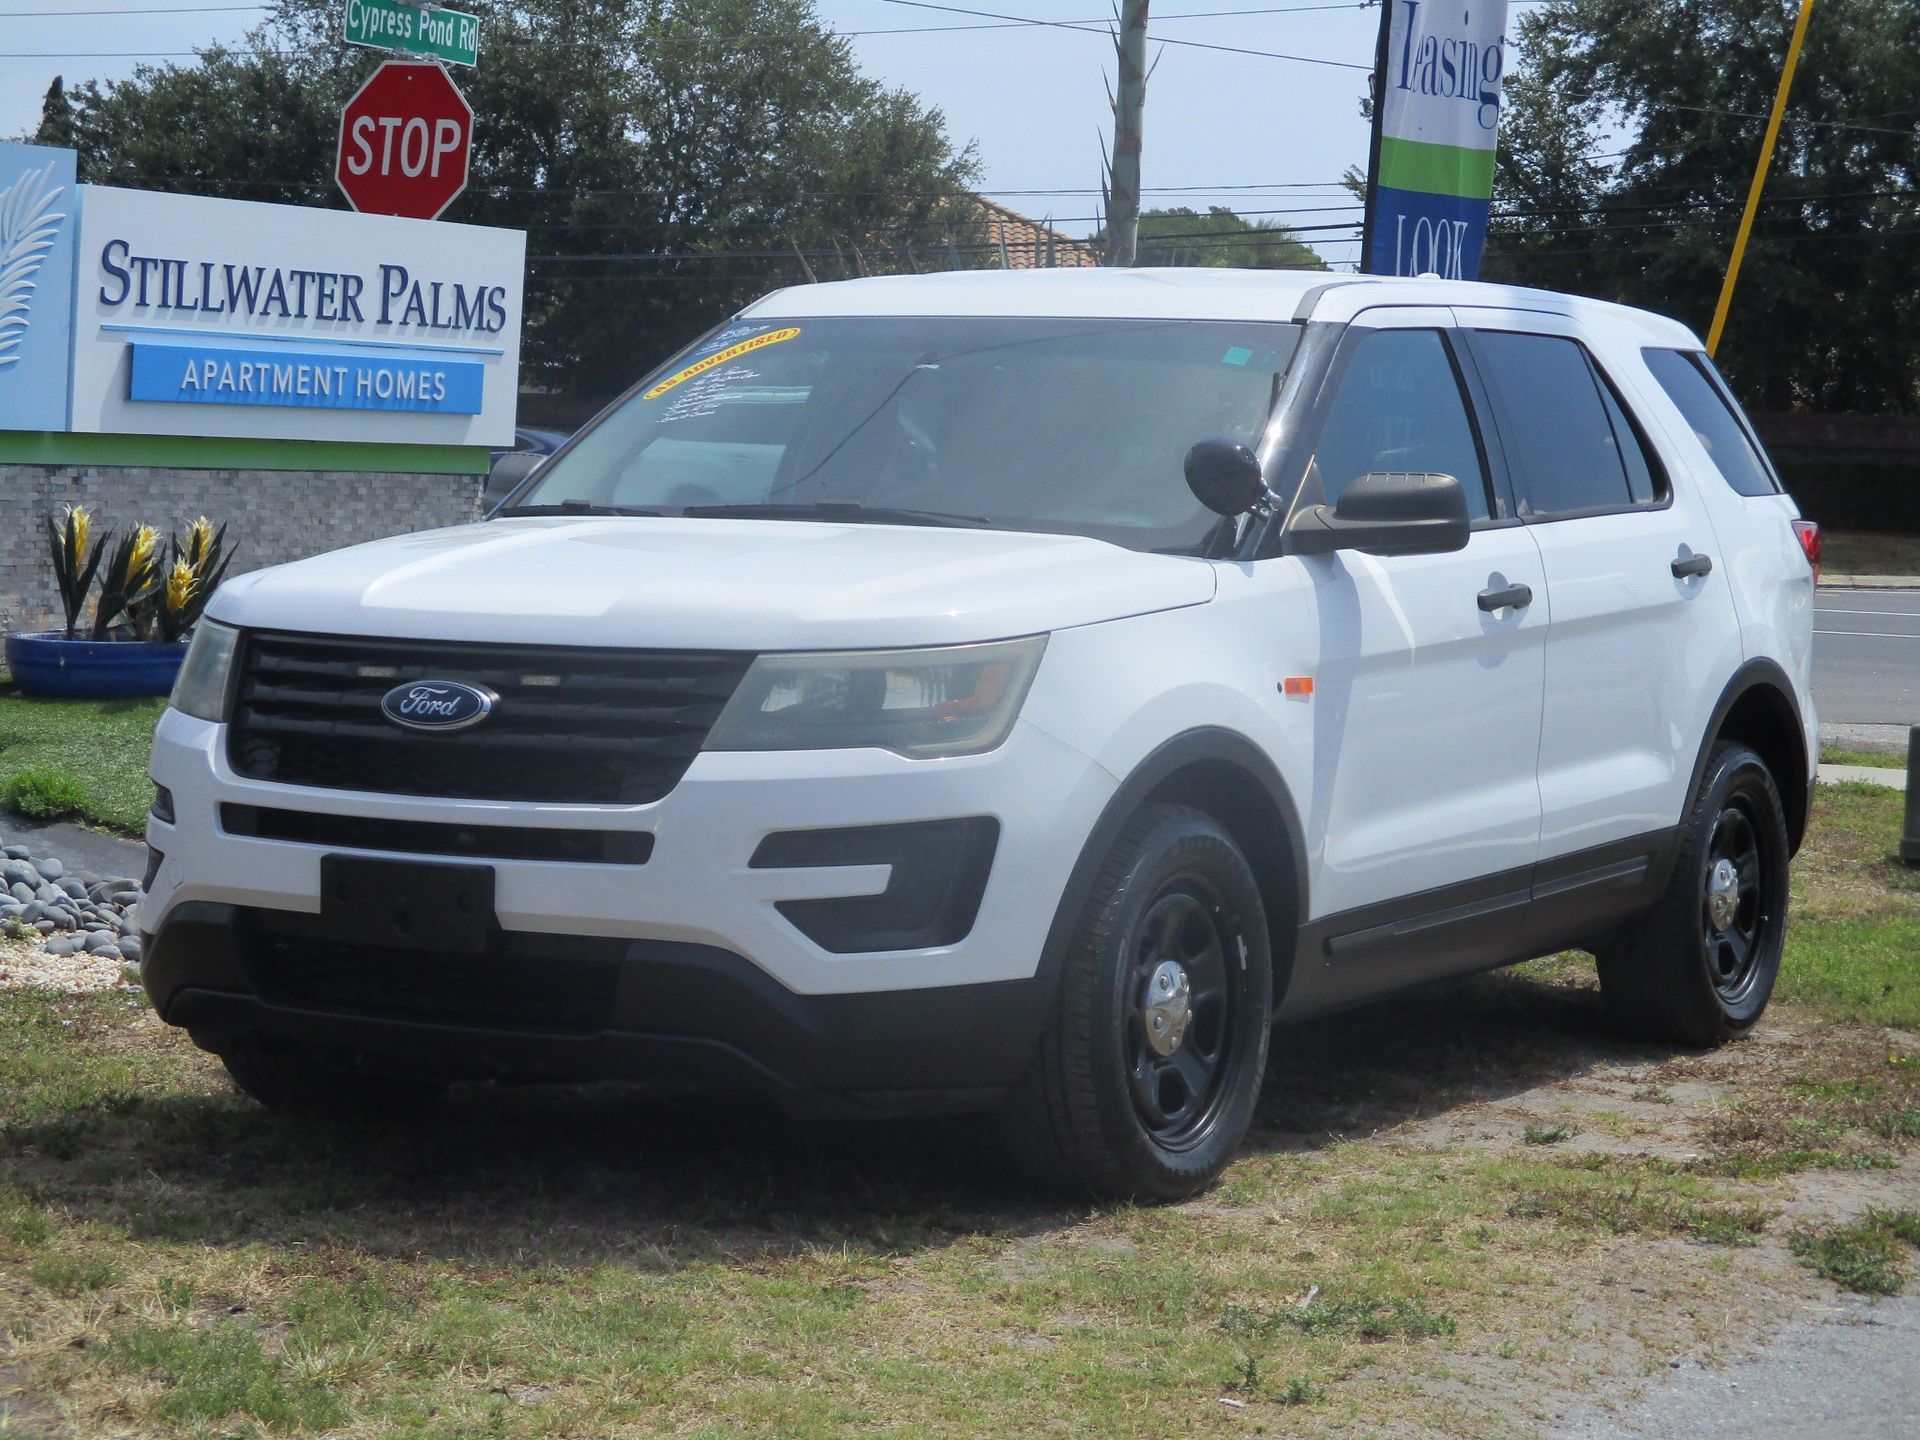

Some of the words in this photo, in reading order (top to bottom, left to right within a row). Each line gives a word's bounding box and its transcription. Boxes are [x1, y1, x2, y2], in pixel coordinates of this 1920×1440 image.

[349, 0, 412, 40] Cypress
[419, 10, 454, 47] Pond
[459, 18, 477, 52] Rd
[347, 115, 462, 178] STOP
[1396, 214, 1469, 280] LOOK
[99, 239, 365, 323] STILLWATER
[376, 263, 507, 333] PALMS
[181, 359, 348, 397] APARTMENT
[356, 369, 447, 401] HOMES
[683, 330, 789, 378] ADVERTISED
[400, 686, 462, 716] Ford
